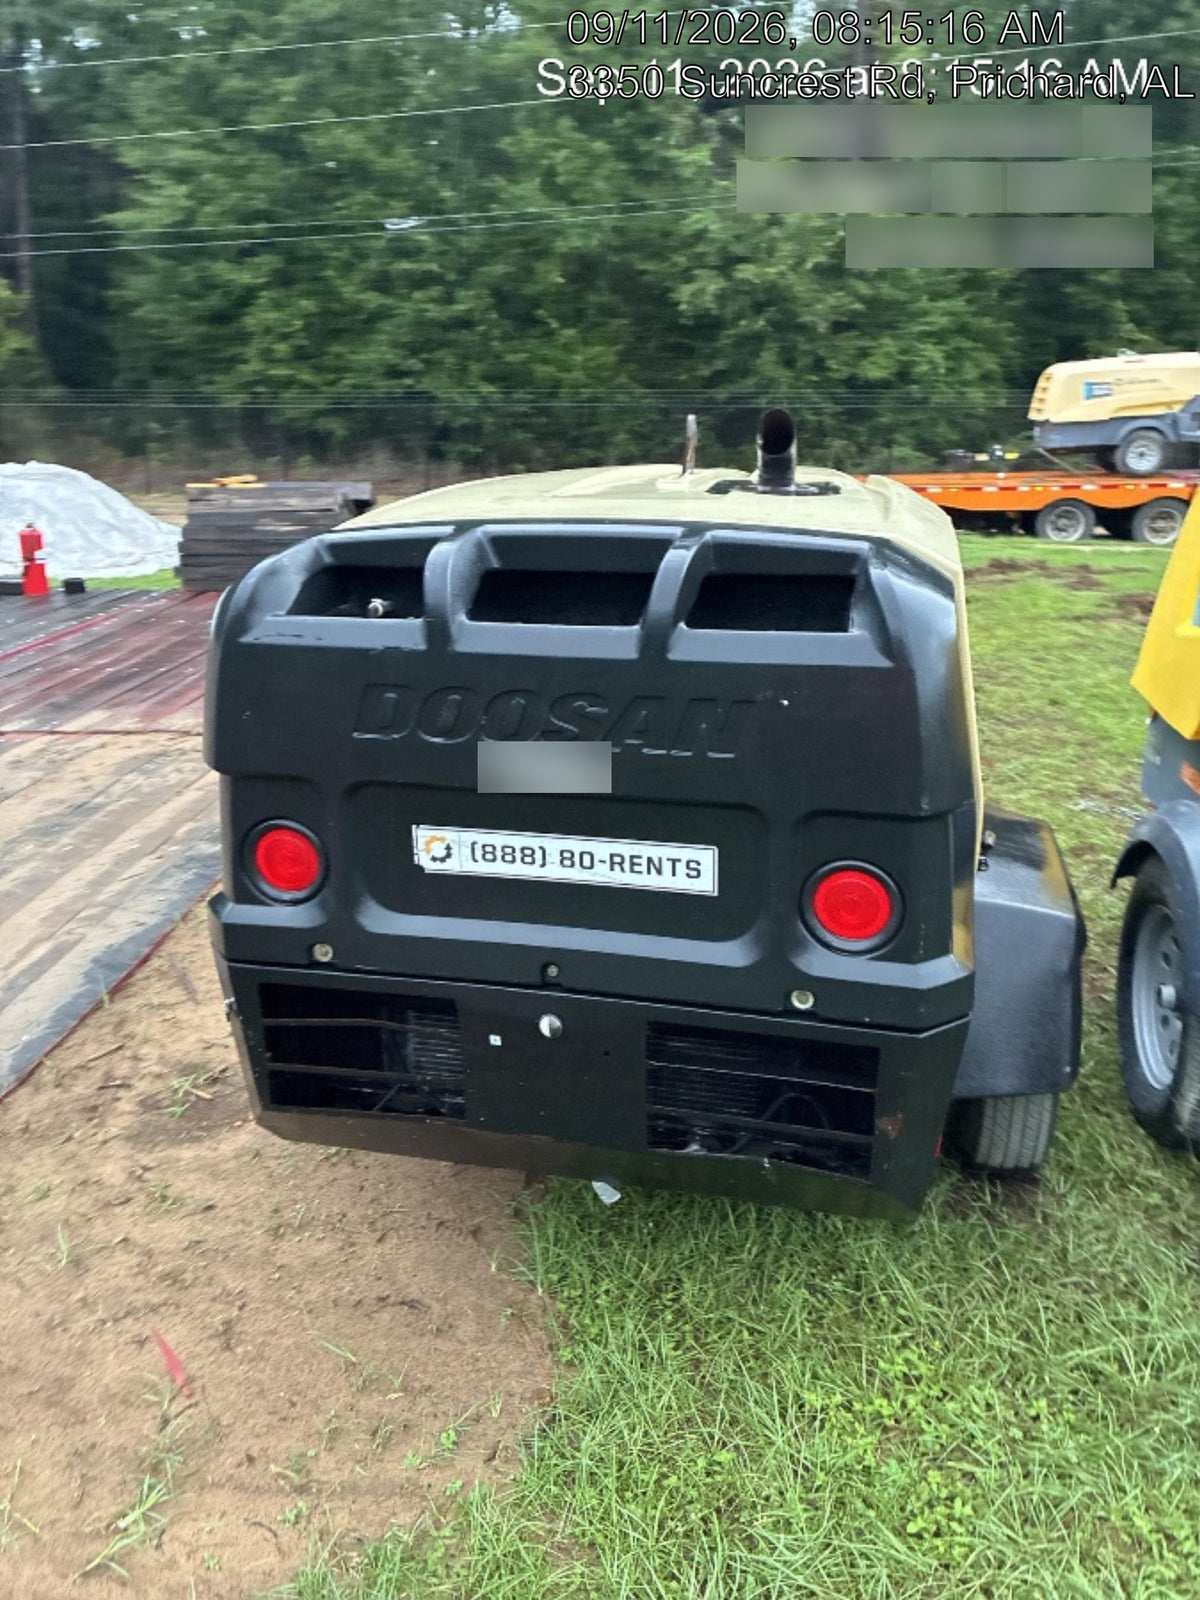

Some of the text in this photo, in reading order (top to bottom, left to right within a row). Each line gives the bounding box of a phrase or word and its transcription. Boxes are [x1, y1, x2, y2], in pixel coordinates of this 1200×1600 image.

[352, 682, 757, 757] DOOSAN
[470, 840, 702, 880] (888) 80-RENTS
